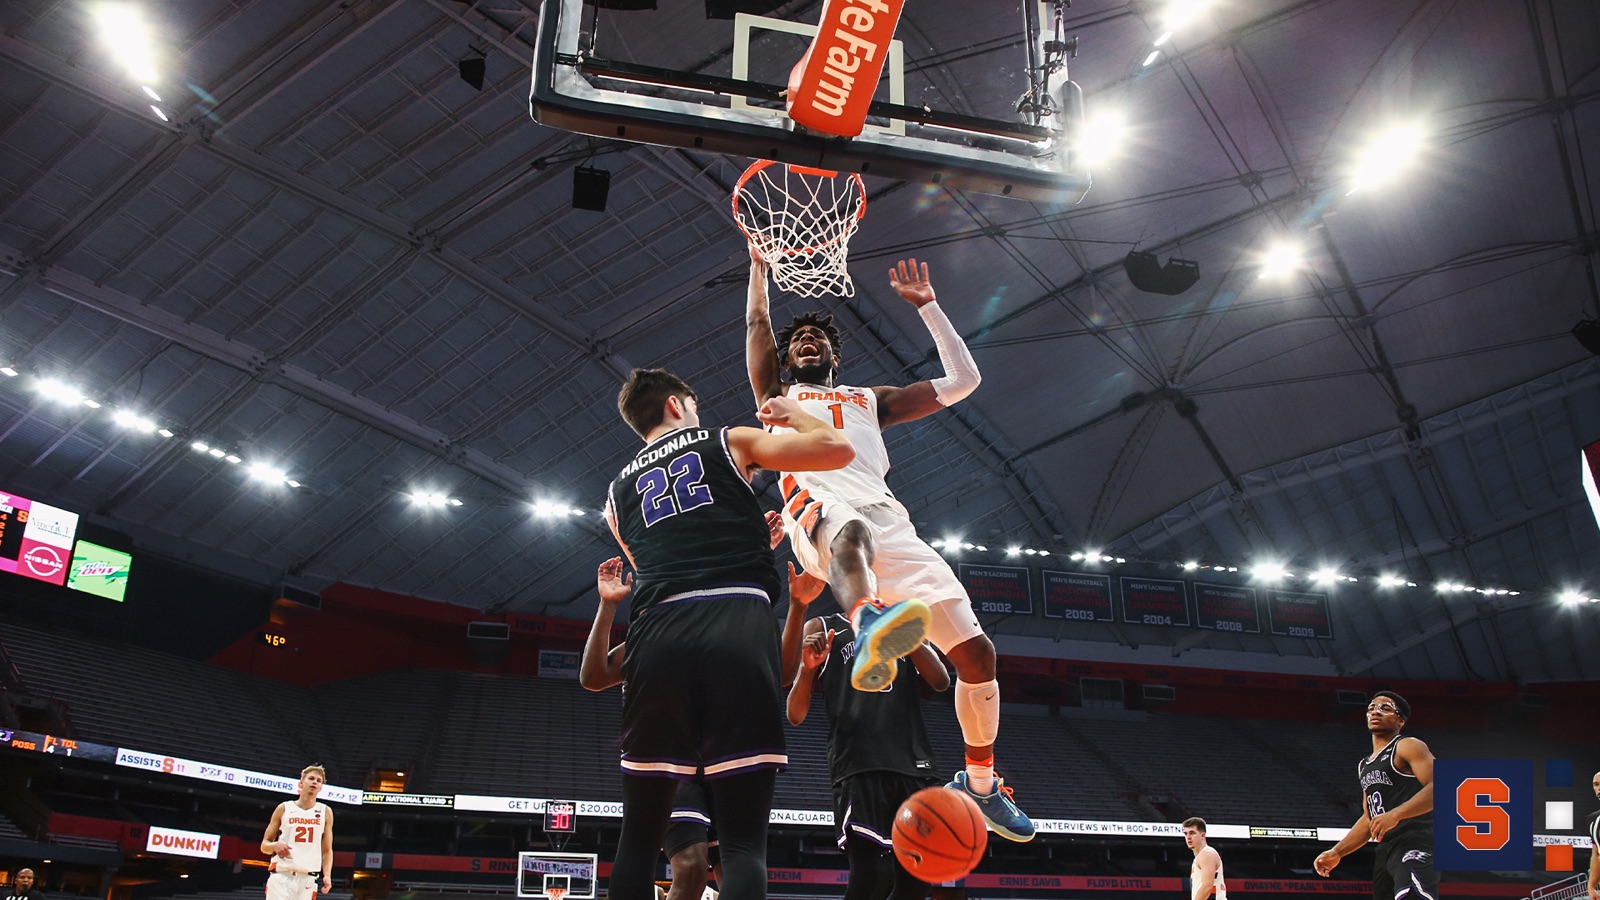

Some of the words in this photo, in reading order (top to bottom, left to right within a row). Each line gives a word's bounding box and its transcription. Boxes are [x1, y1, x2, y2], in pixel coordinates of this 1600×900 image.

[797, 391, 869, 410] ORANGE
[827, 403, 845, 429] 1
[621, 429, 709, 479] MACDONALD
[635, 451, 714, 528] 22
[24, 553, 63, 569] NISSAN
[1069, 578, 1104, 587] BASKETBALL
[981, 602, 1012, 613] 2002
[1065, 609, 1094, 620] 2003
[1143, 614, 1172, 626] 2004
[1216, 620, 1243, 632] 2008
[1288, 626, 1315, 638] 2009
[12, 739, 36, 751] POSS
[61, 738, 78, 749] TOL
[66, 748, 72, 757] 1
[119, 753, 162, 769] ASSISTS
[176, 763, 185, 773] 11
[224, 772, 235, 782] 10
[244, 775, 294, 792] TURNOVERS
[348, 793, 358, 802] 12
[363, 794, 385, 802] ARMY
[385, 795, 422, 804] NATIONAL
[422, 797, 447, 806] GUARD
[508, 800, 530, 810] GET
[1367, 791, 1386, 818] 12
[288, 817, 321, 826] ORANGE
[551, 814, 571, 829] 30
[1042, 821, 1098, 832] INTERVIEWS
[1101, 824, 1124, 833] WITH
[1126, 824, 1149, 833] 800+
[294, 826, 314, 843] 21
[151, 834, 217, 852] DUNKIN'
[1567, 838, 1581, 846] GET
[1000, 877, 1029, 887] ERNIE
[1032, 878, 1062, 888] DAVIS
[1087, 879, 1118, 889] FLOYD
[1120, 880, 1152, 889] LITTLE
[1244, 881, 1282, 891] DWAYNE
